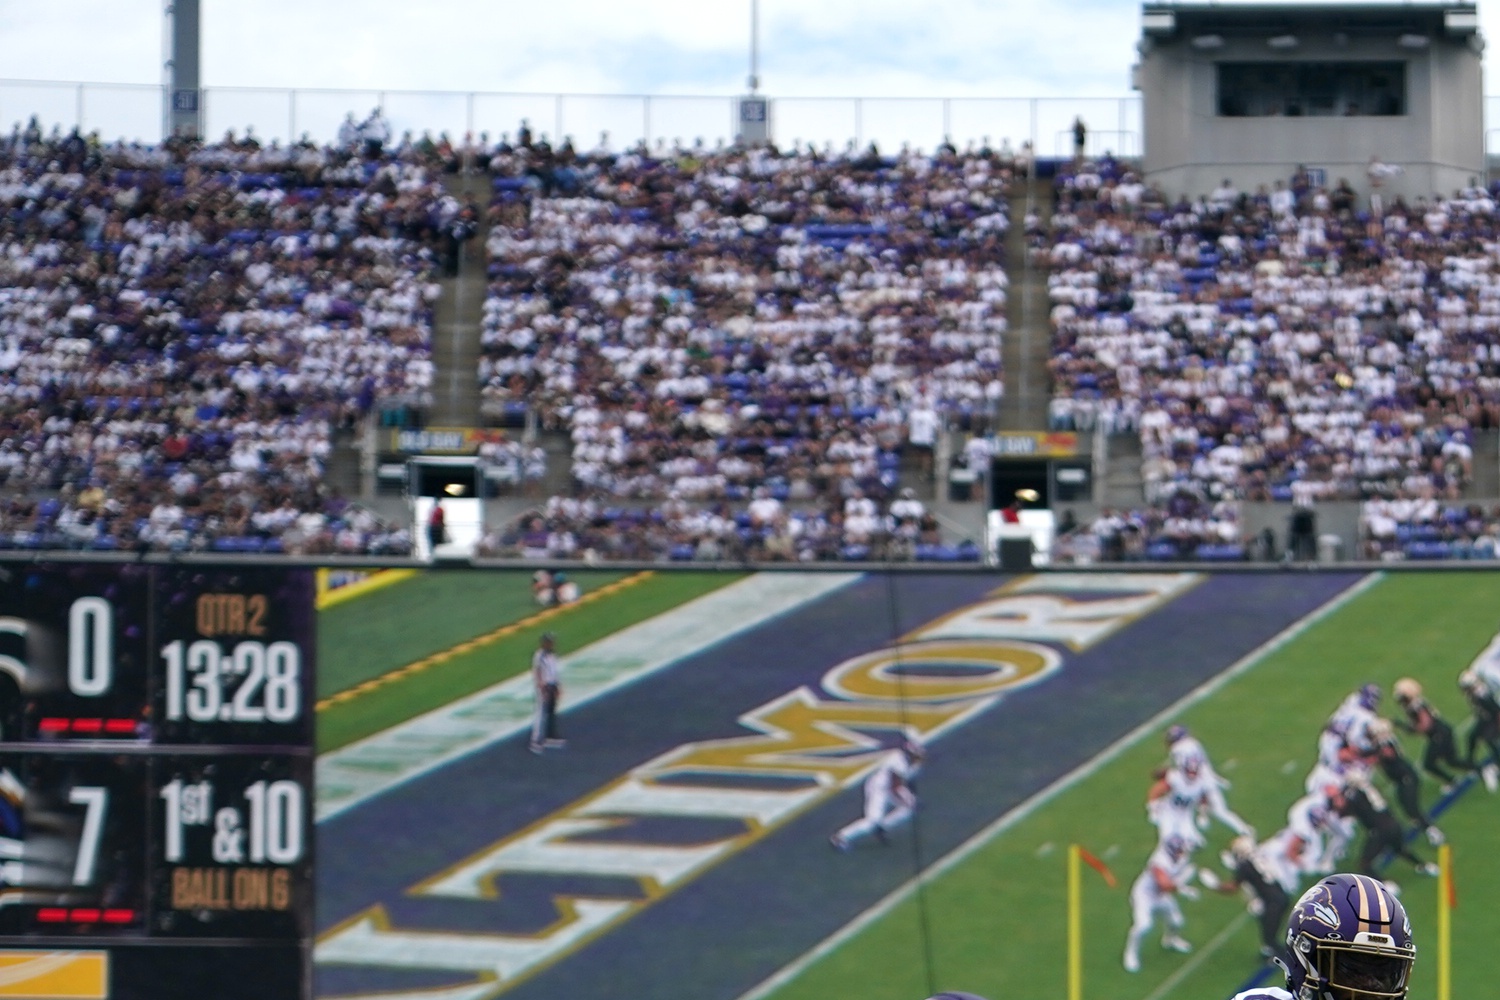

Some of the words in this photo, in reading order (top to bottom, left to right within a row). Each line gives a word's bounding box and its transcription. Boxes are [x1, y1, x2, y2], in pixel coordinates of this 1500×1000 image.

[68, 596, 112, 696] 0
[197, 594, 245, 636] QTR
[248, 595, 267, 635] 2
[161, 639, 300, 722] 13:28
[70, 786, 106, 885] 7
[161, 780, 212, 862] 1st
[212, 807, 243, 863] &
[244, 780, 302, 864] 10
[171, 868, 229, 909] BALL
[232, 869, 268, 909] ON
[271, 868, 289, 909] 6
